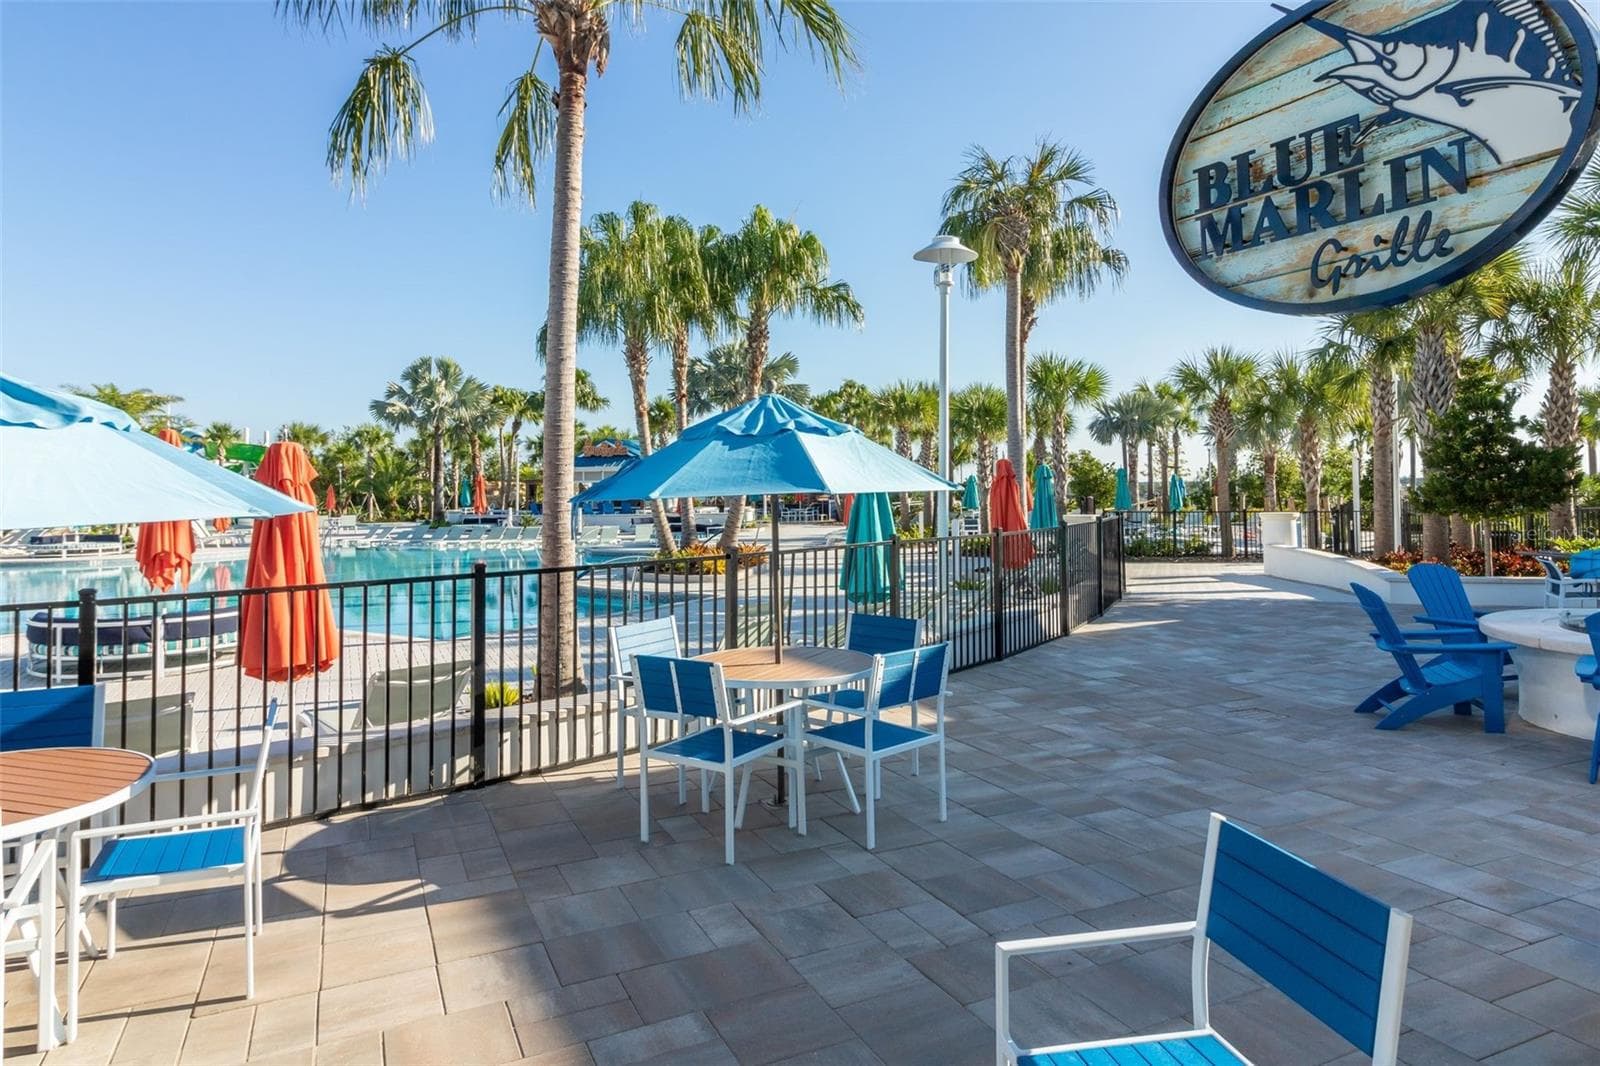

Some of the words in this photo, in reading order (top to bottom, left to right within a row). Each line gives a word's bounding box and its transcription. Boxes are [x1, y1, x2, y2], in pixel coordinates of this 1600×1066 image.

[1194, 114, 1364, 212] BLUE
[1197, 137, 1471, 260] MARLIN
[1311, 211, 1455, 295] Grille
